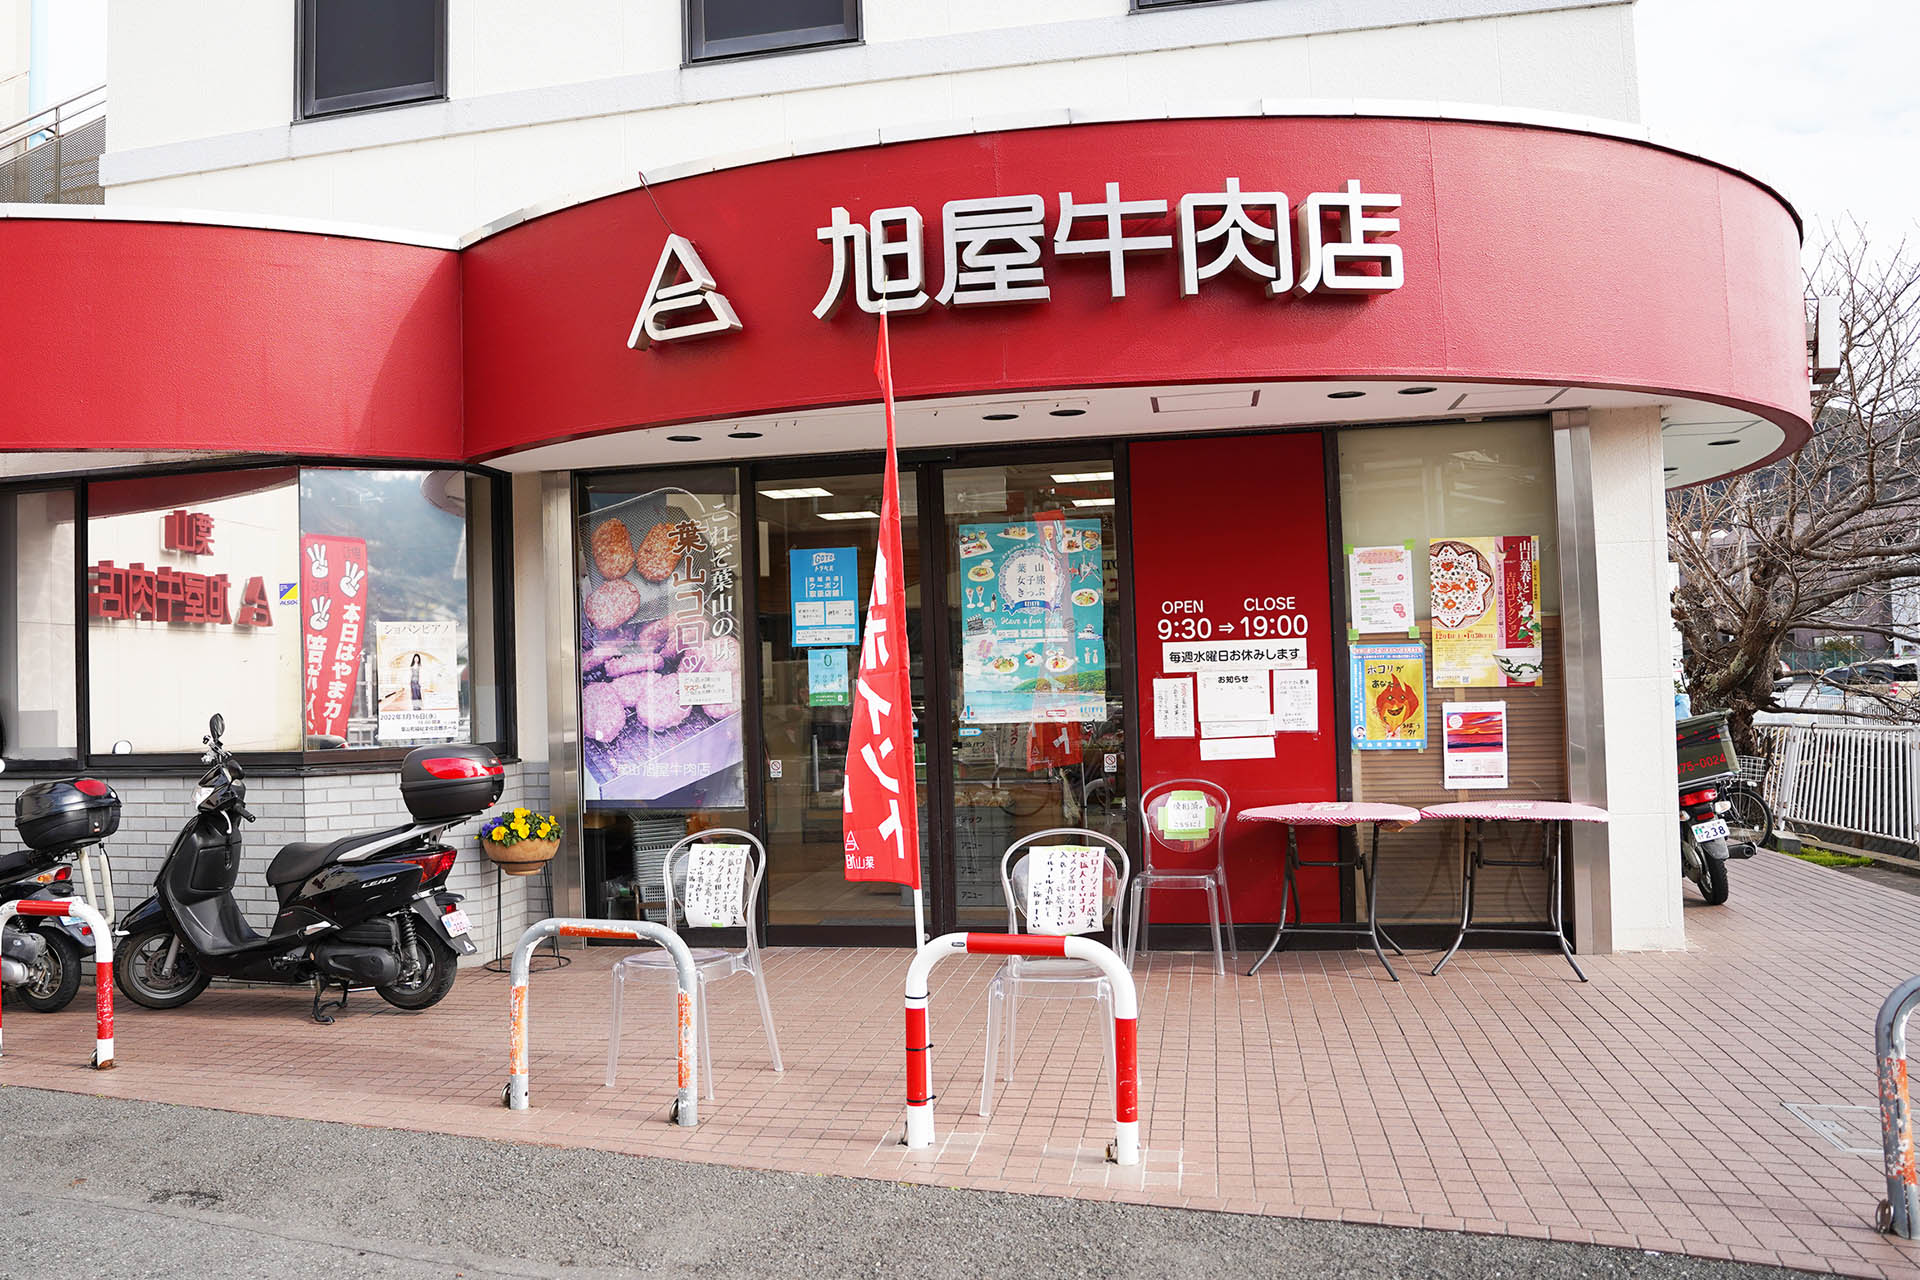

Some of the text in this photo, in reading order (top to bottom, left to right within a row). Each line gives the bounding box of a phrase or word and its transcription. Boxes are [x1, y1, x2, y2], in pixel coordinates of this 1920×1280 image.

[813, 177, 1404, 319] 旭屋牛肉店
[709, 502, 736, 662] これぞ葉山の味
[668, 519, 709, 673] 葉山コロッ
[1243, 596, 1296, 612] CLOSE
[1161, 600, 1204, 614] OPEN
[1157, 618, 1212, 640] 9:30
[1240, 614, 1309, 637] 19:00
[1169, 648, 1300, 663] 毎週水曜日お休みします
[1218, 675, 1249, 684] お知らせ
[1704, 825, 1726, 839] 238
[361, 876, 397, 889] LEAD
